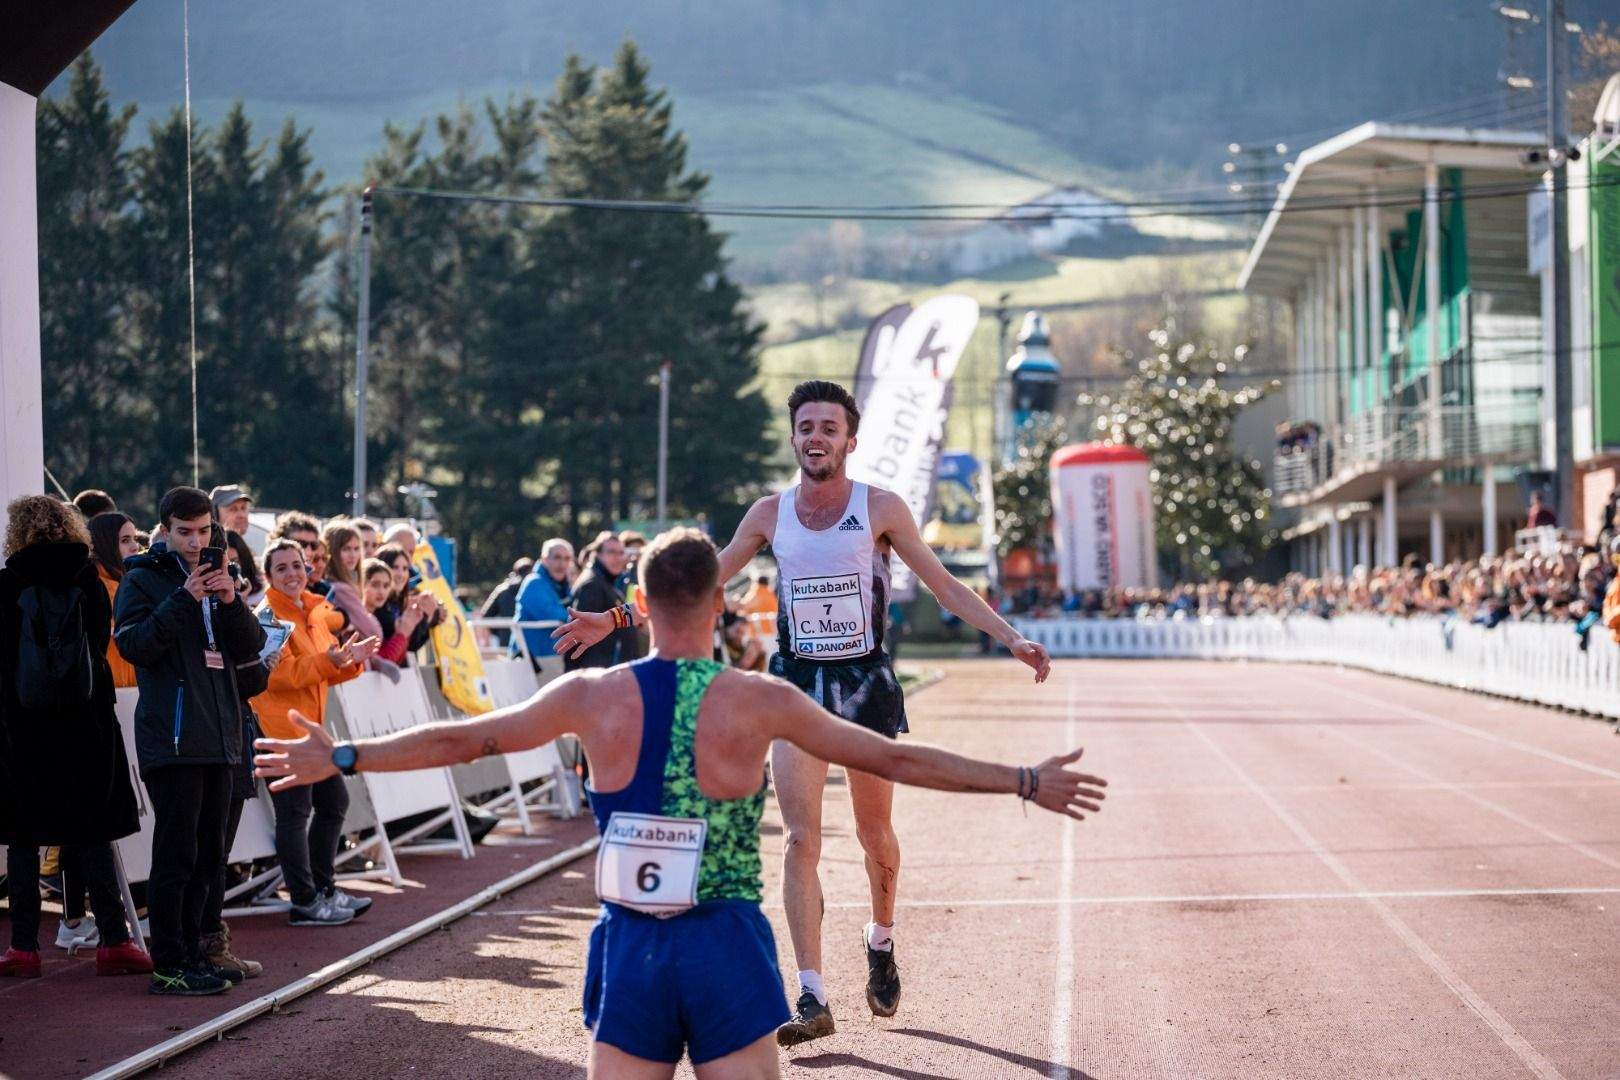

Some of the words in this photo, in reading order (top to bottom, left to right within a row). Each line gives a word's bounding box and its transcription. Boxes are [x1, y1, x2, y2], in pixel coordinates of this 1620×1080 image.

[868, 385, 926, 488] bank
[794, 580, 857, 595] kutxabank
[822, 604, 833, 615] 7
[800, 620, 815, 634] C.
[819, 619, 857, 635] Mayo
[816, 639, 863, 652] DANOBAT
[613, 824, 697, 844] kutxabank
[637, 862, 662, 892] 6
